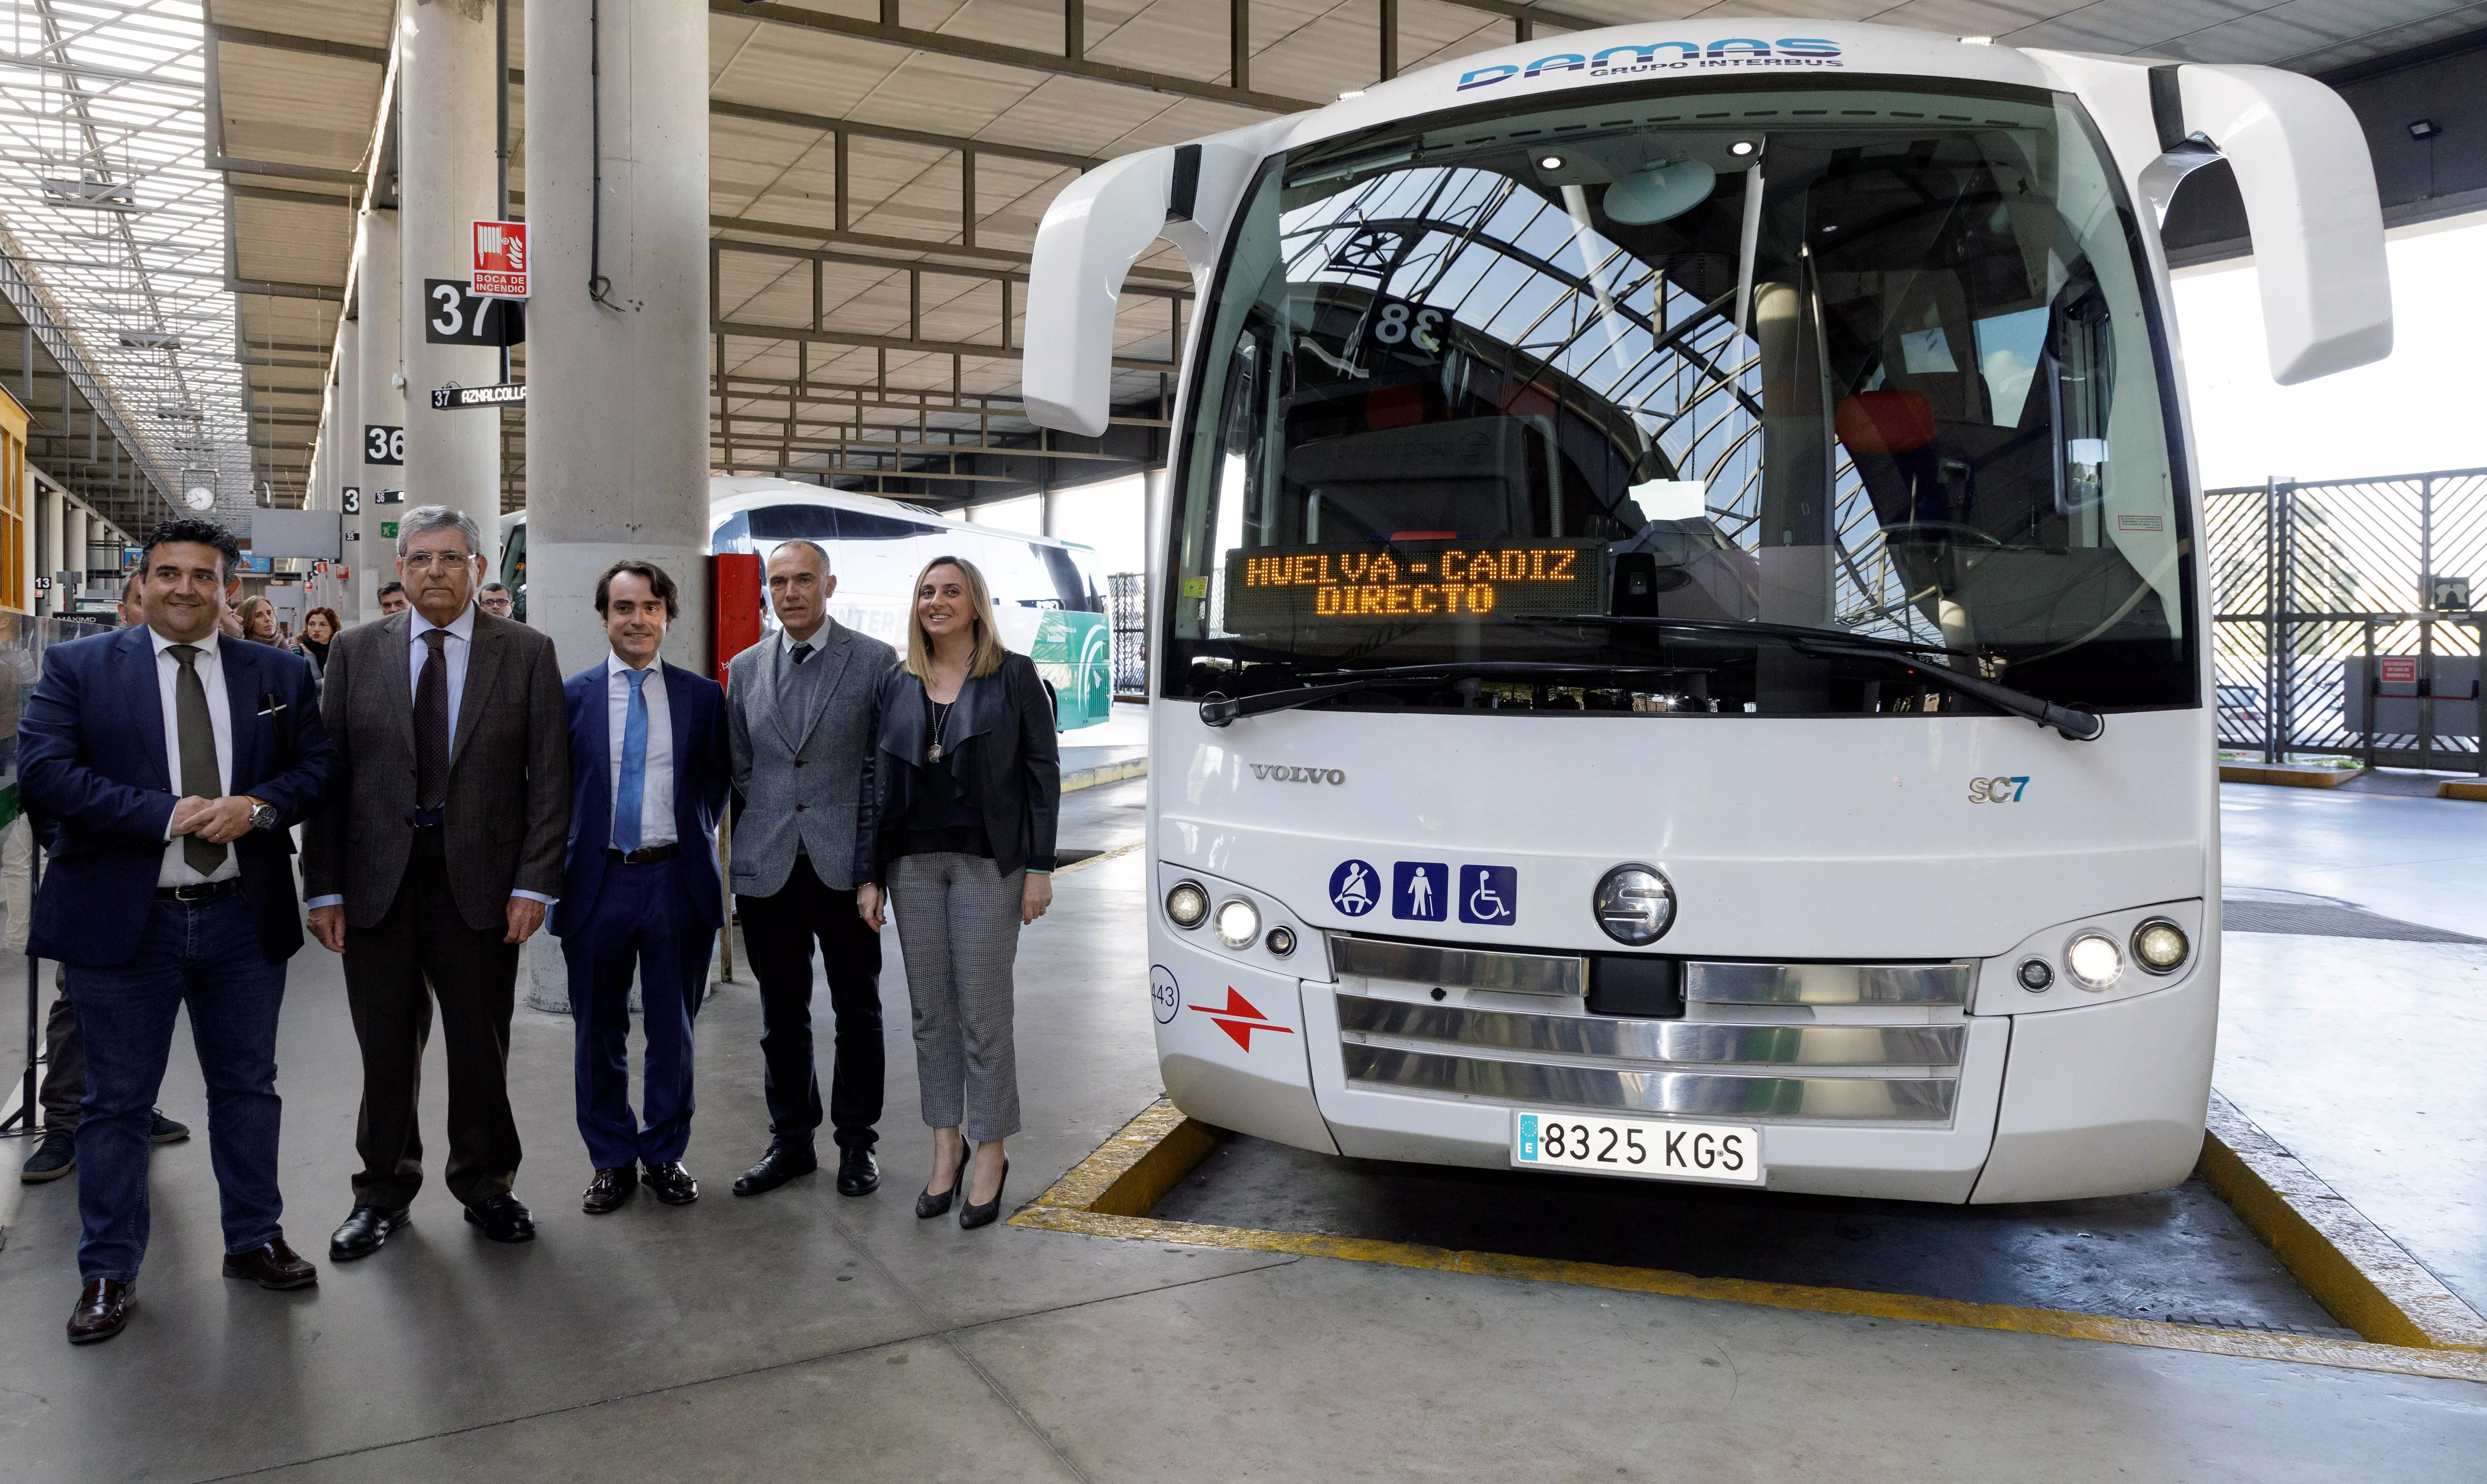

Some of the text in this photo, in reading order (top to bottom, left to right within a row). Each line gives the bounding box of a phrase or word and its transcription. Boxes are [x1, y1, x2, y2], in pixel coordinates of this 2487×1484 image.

[1456, 38, 1841, 92] DAMAS
[1590, 58, 1844, 77] GRUPO INTERBUS
[476, 274, 525, 285] BOCA DE
[476, 283, 525, 294] INCENDIO
[432, 285, 493, 336] 37
[435, 391, 450, 407] 37
[368, 428, 404, 460] 36
[376, 493, 385, 503] 36
[1246, 552, 1397, 587] HUELVA
[1441, 549, 1576, 581] CADIZ
[35, 577, 50, 588] 13
[1316, 583, 1494, 614] DIRECTO
[1250, 763, 1346, 786] VOLVO
[1968, 776, 2030, 804] SC7
[1151, 982, 1175, 1007] 443
[1525, 1122, 1744, 1171] E 8325 KGS
